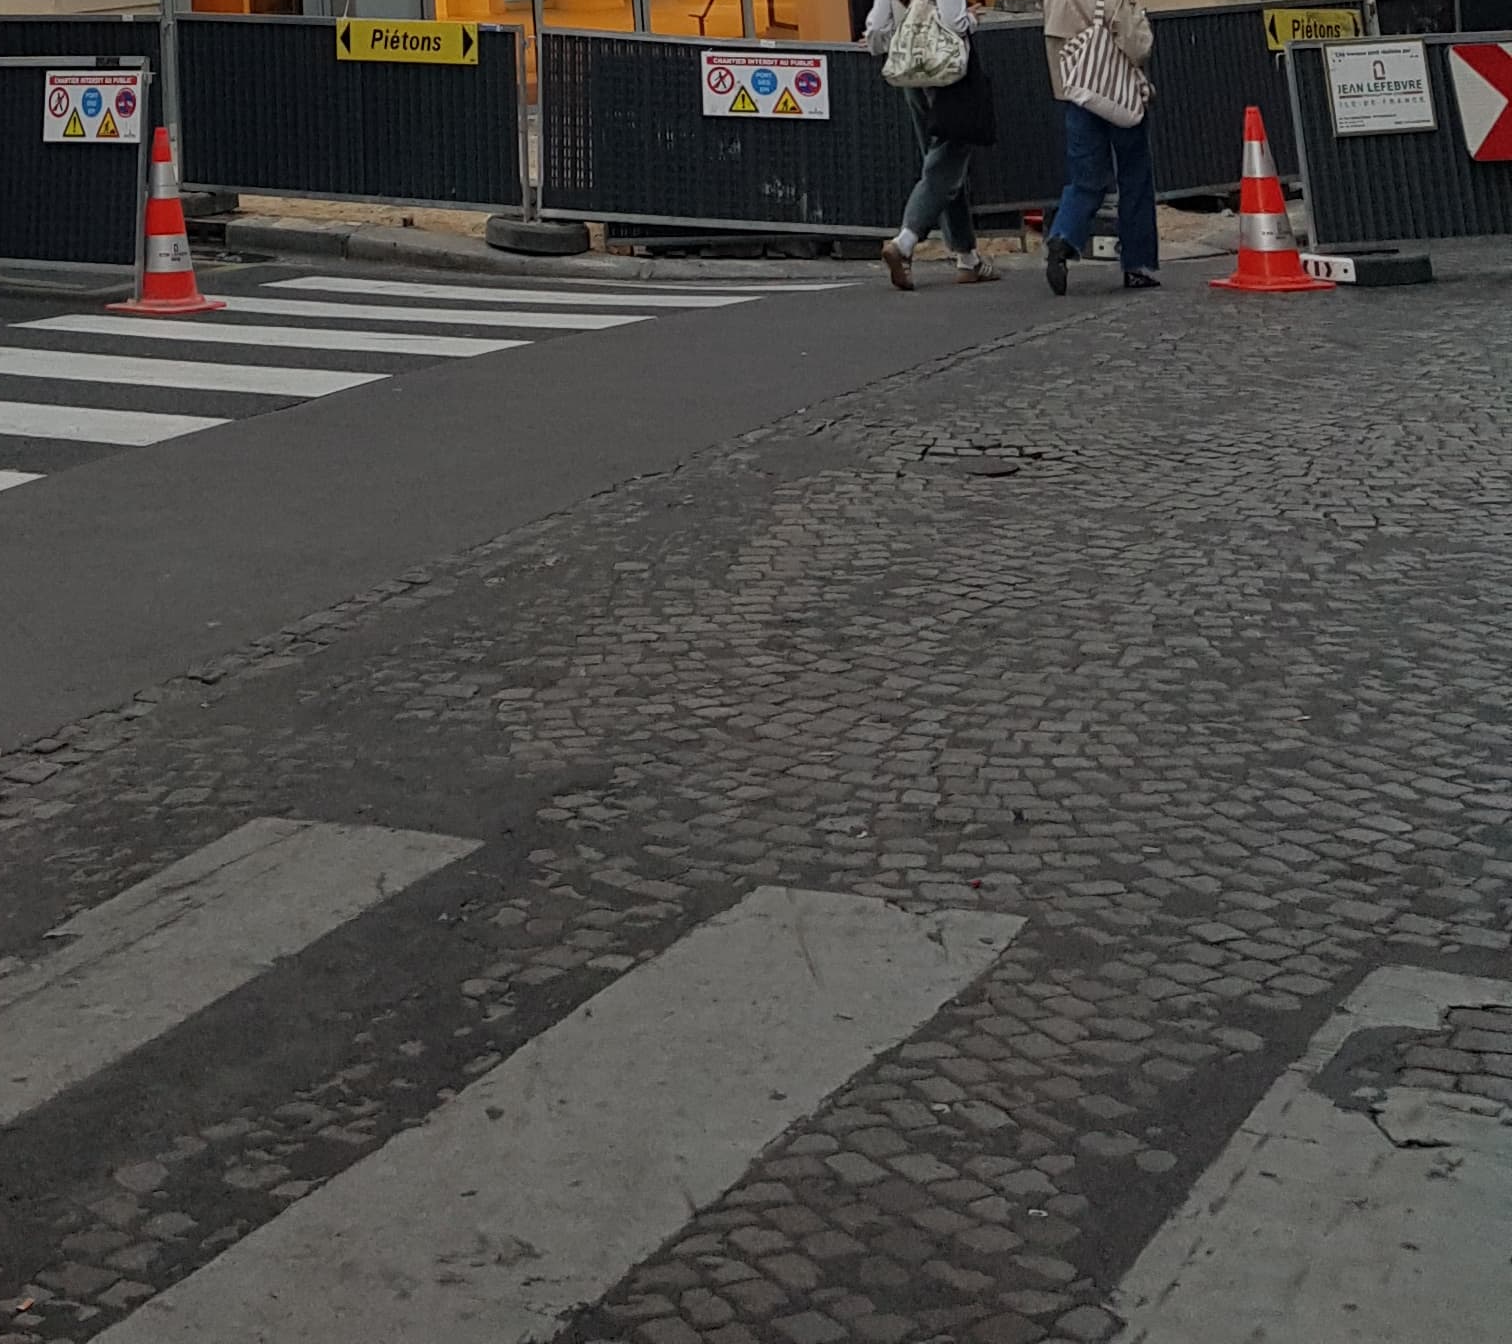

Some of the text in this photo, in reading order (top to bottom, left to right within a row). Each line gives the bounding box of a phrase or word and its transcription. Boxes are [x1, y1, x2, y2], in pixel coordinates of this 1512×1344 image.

[1291, 18, 1341, 39] Piétons
[370, 28, 442, 52] Piétons
[1337, 79, 1423, 95] JEAN LEFEBVRE
